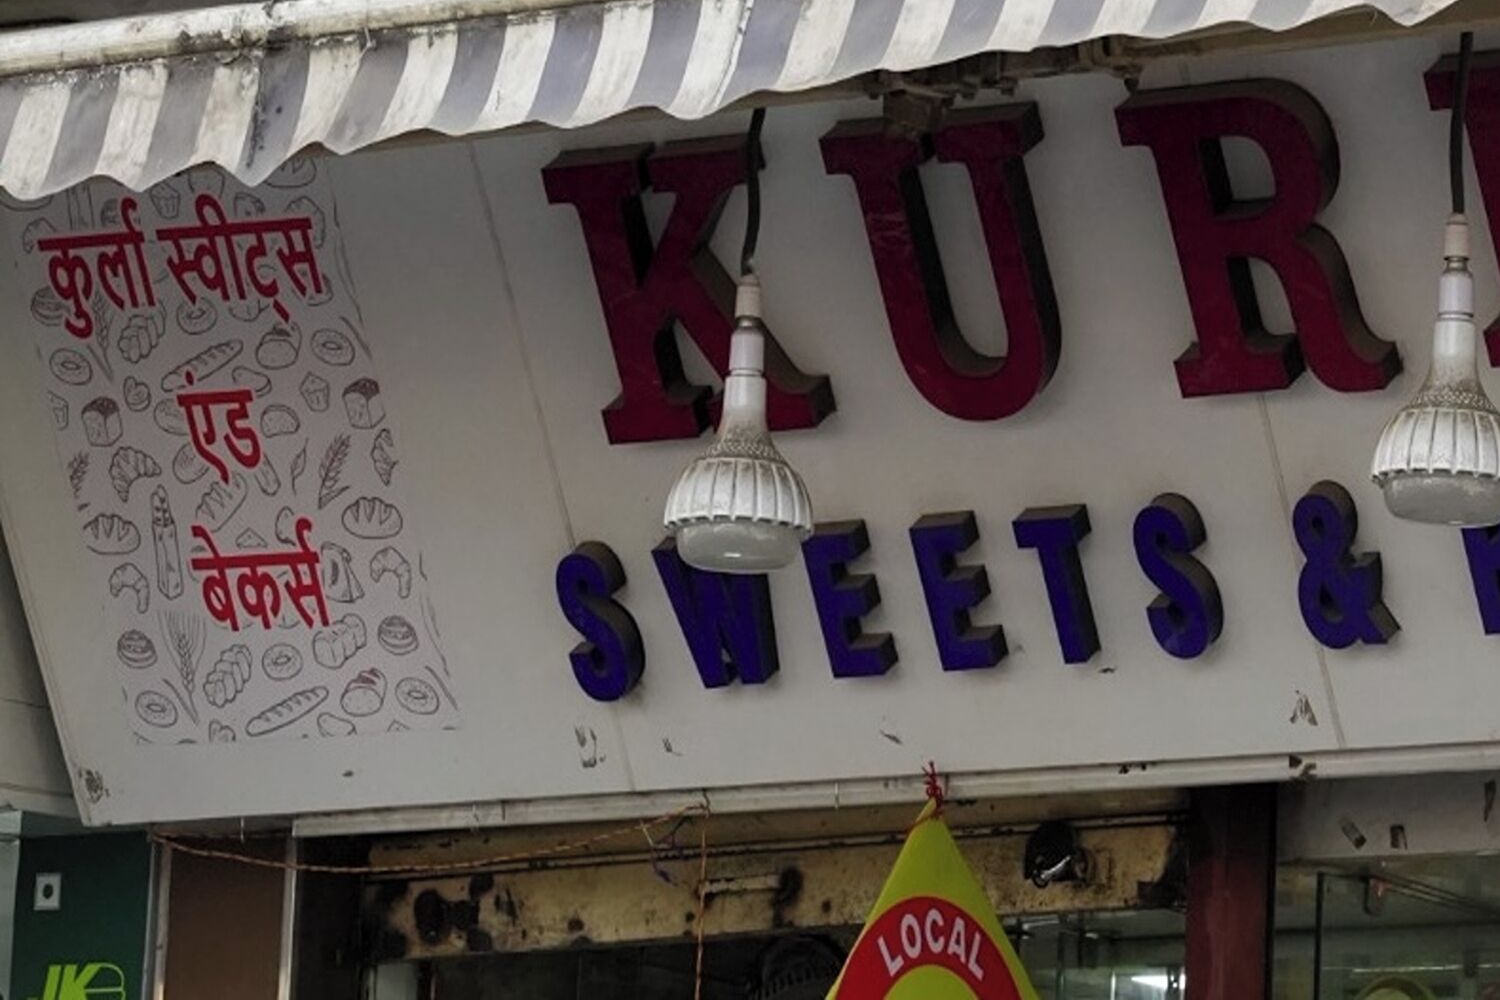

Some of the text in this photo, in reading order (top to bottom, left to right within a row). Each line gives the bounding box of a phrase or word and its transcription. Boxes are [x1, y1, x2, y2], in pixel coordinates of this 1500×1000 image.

[38, 194, 324, 338] कुर्ला स्वीट्स
[176, 371, 263, 482] एंड
[190, 517, 333, 632] बेकर्स
[556, 492, 1224, 702] SWEETS
[1292, 479, 1400, 650] &
[877, 908, 985, 982] LOCAL
